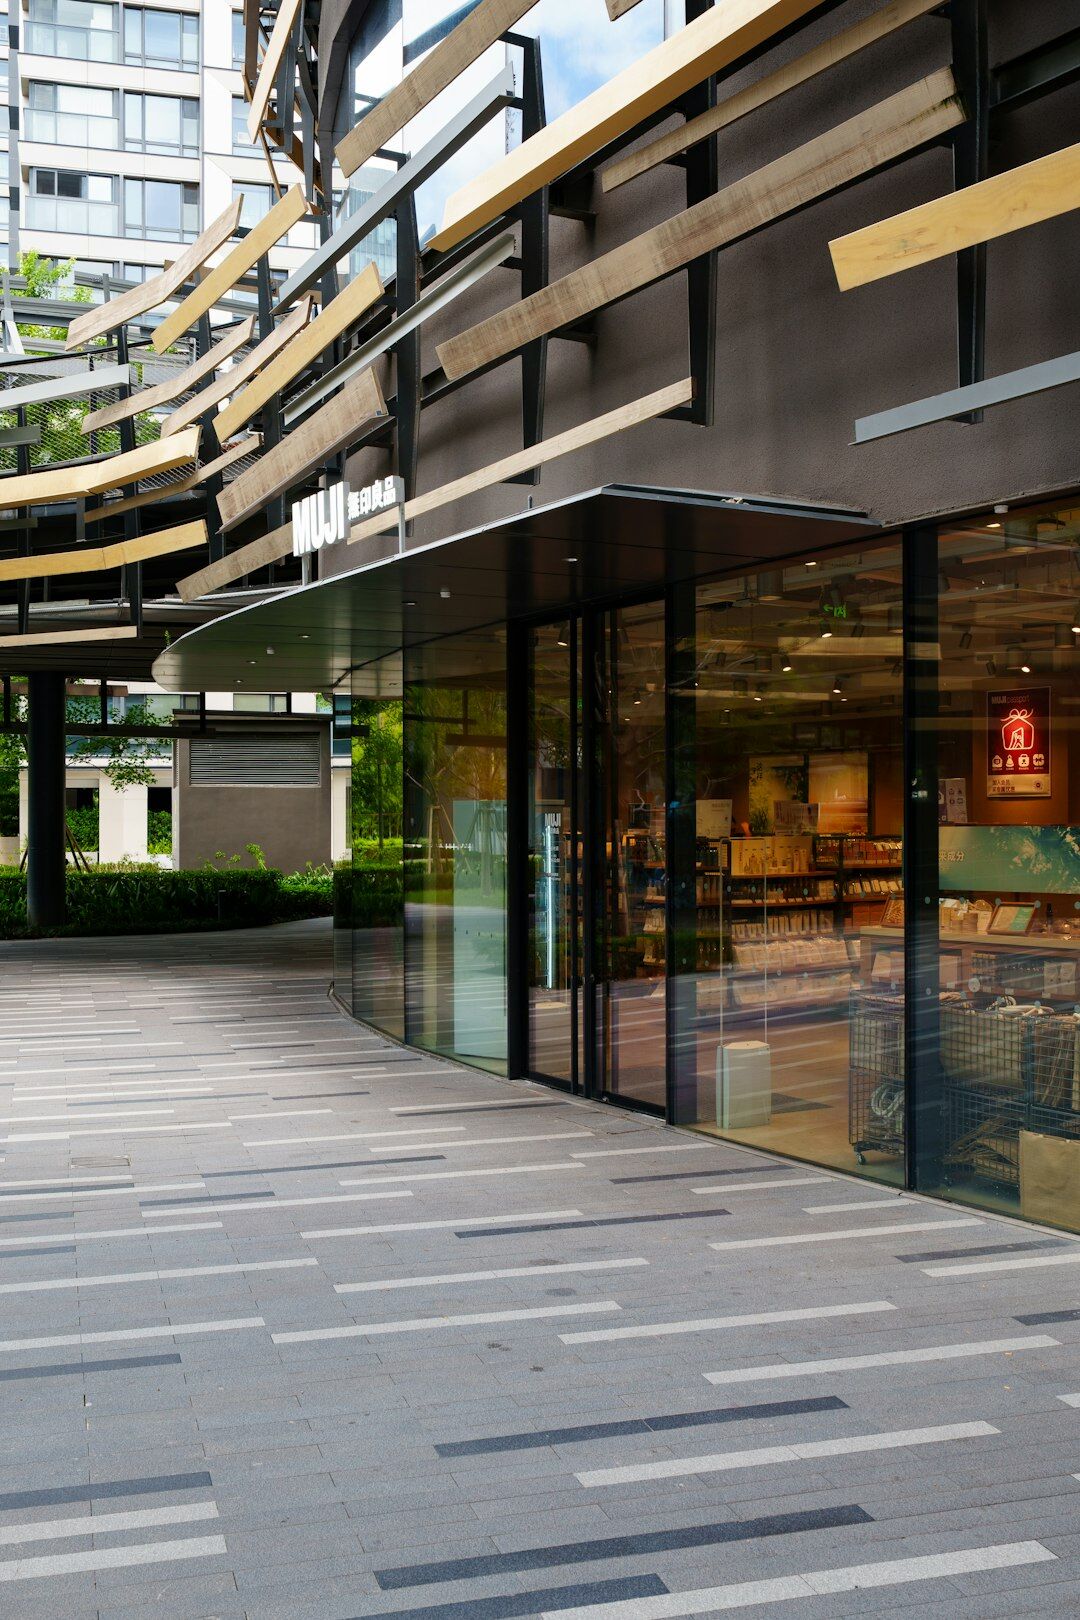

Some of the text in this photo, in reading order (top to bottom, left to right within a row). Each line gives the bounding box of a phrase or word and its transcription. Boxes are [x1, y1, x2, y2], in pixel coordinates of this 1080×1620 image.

[347, 475, 400, 520] 無印良品
[292, 481, 347, 556] MUJI
[992, 696, 1006, 704] MUJI
[545, 813, 561, 827] MUJI
